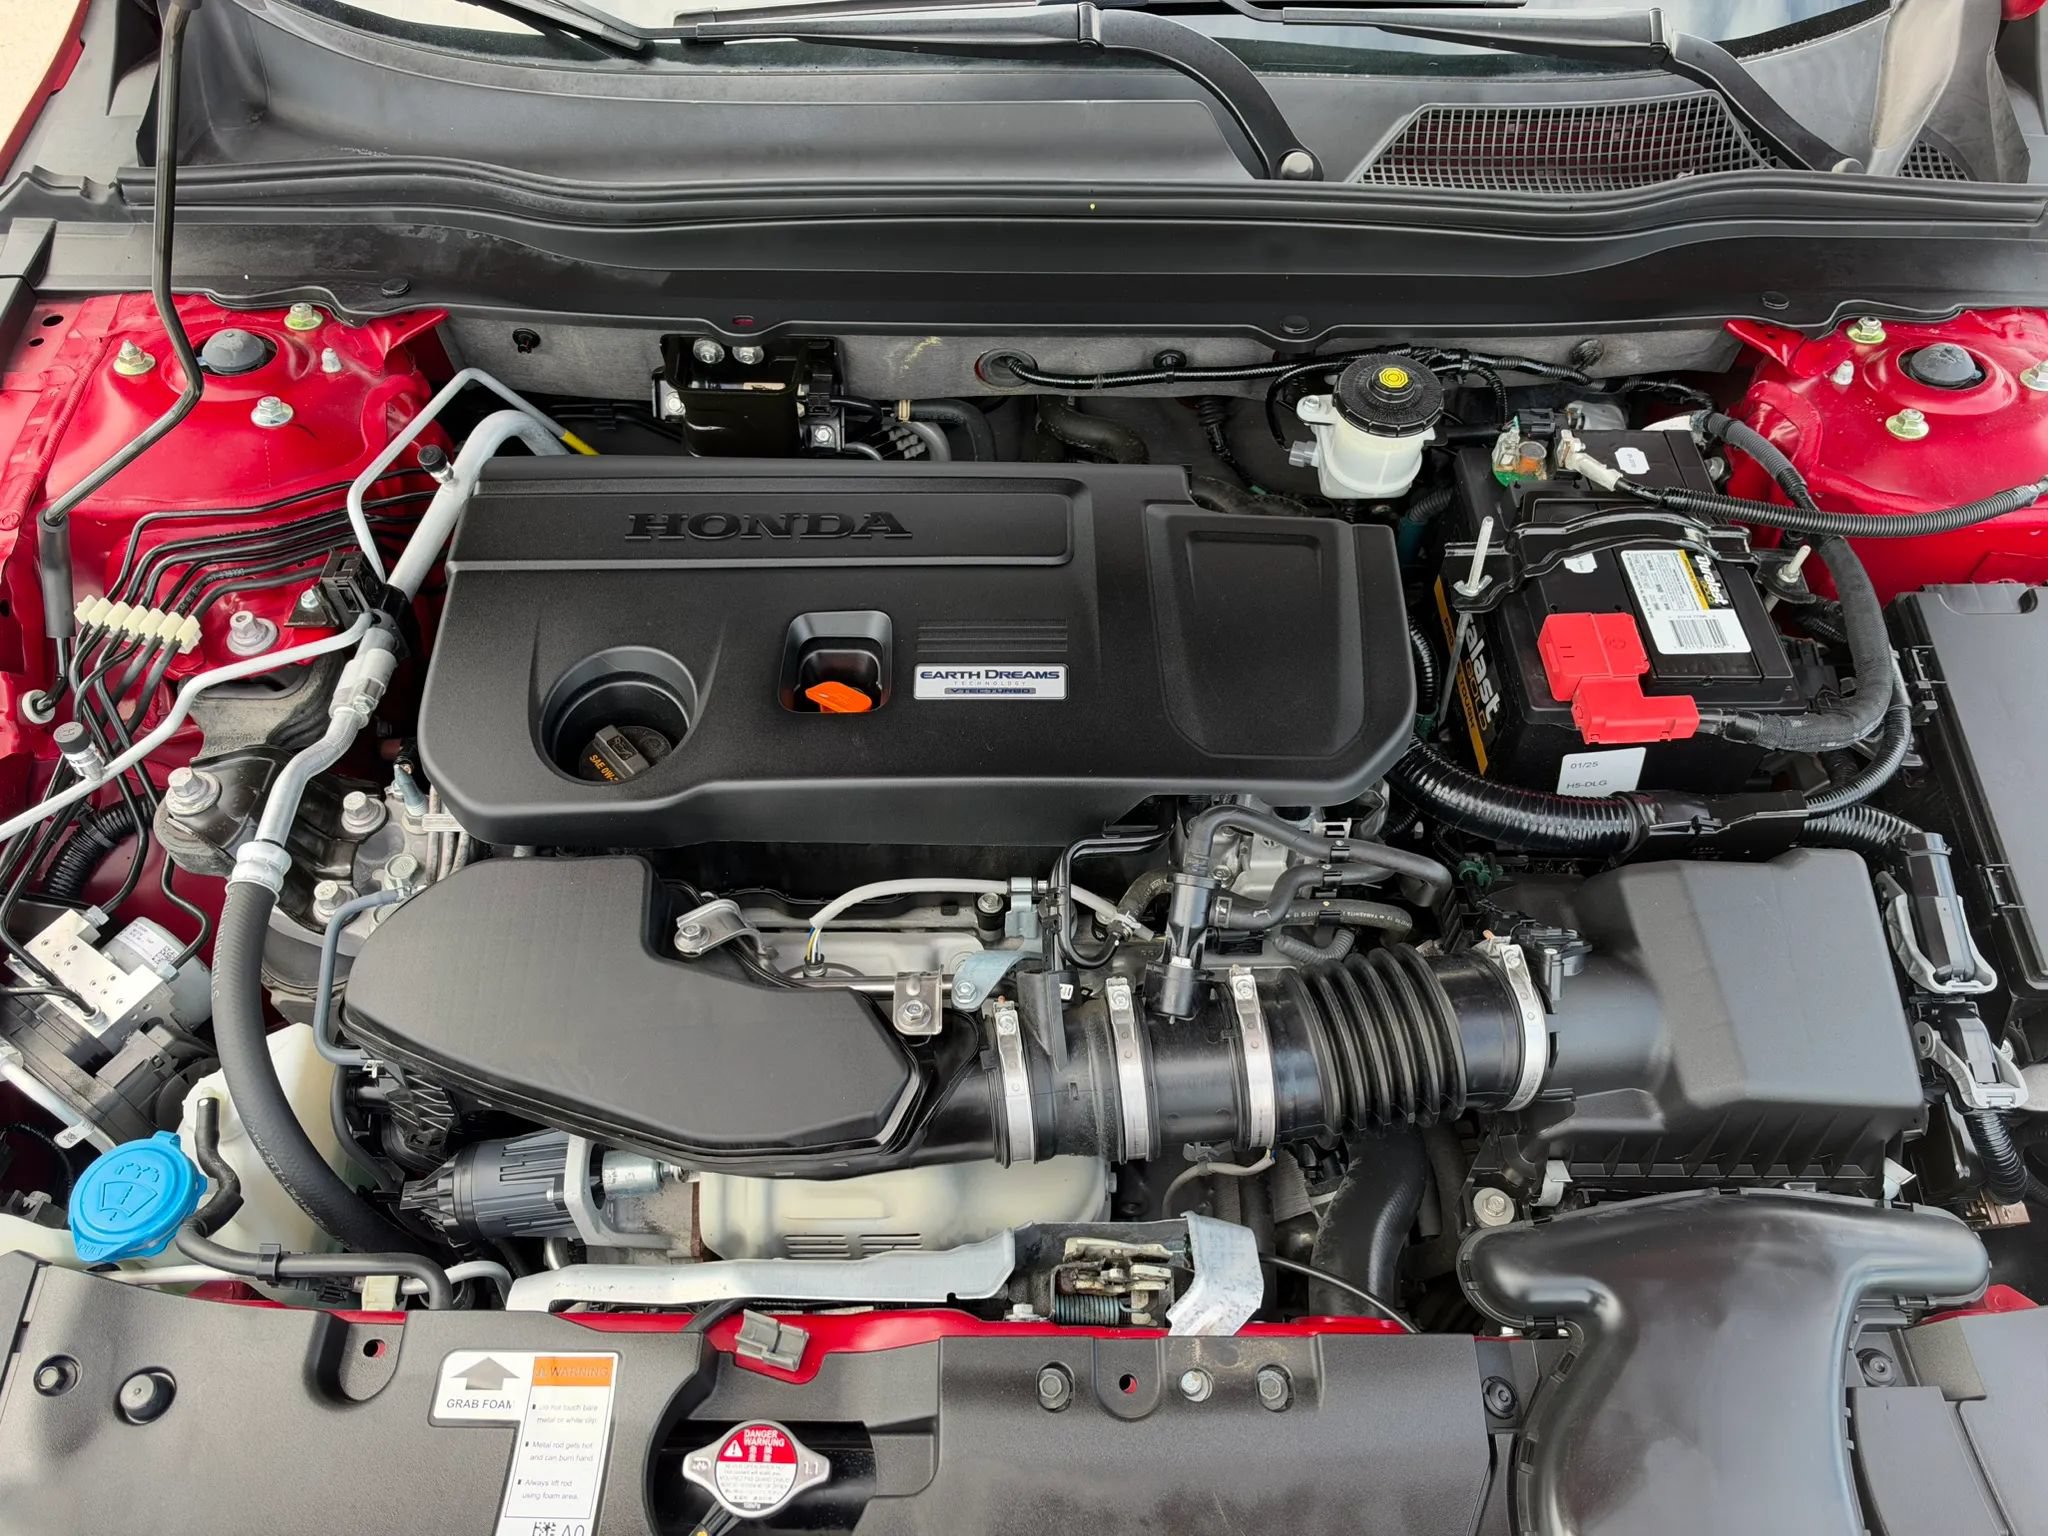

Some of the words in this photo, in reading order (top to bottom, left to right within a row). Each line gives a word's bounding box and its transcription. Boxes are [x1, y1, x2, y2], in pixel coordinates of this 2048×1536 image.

[624, 511, 913, 540] HONDA
[1694, 553, 1729, 605] Duralast
[1465, 613, 1501, 723] ralast
[919, 670, 981, 680] EARTH
[985, 669, 1061, 680] DREAMS
[1465, 658, 1488, 731] GOLD
[589, 754, 605, 770] SAE
[1570, 761, 1599, 769] 01/25
[550, 1366, 609, 1377] WARNING
[446, 1398, 479, 1409] GRAB
[744, 1429, 779, 1438] DANGER
[532, 1441, 551, 1449] Metal
[553, 1441, 564, 1449] rod
[566, 1442, 580, 1450] gets
[582, 1441, 593, 1449] hot
[525, 1479, 549, 1487] Always
[561, 1479, 573, 1487] rod
[542, 1492, 560, 1500] foam
